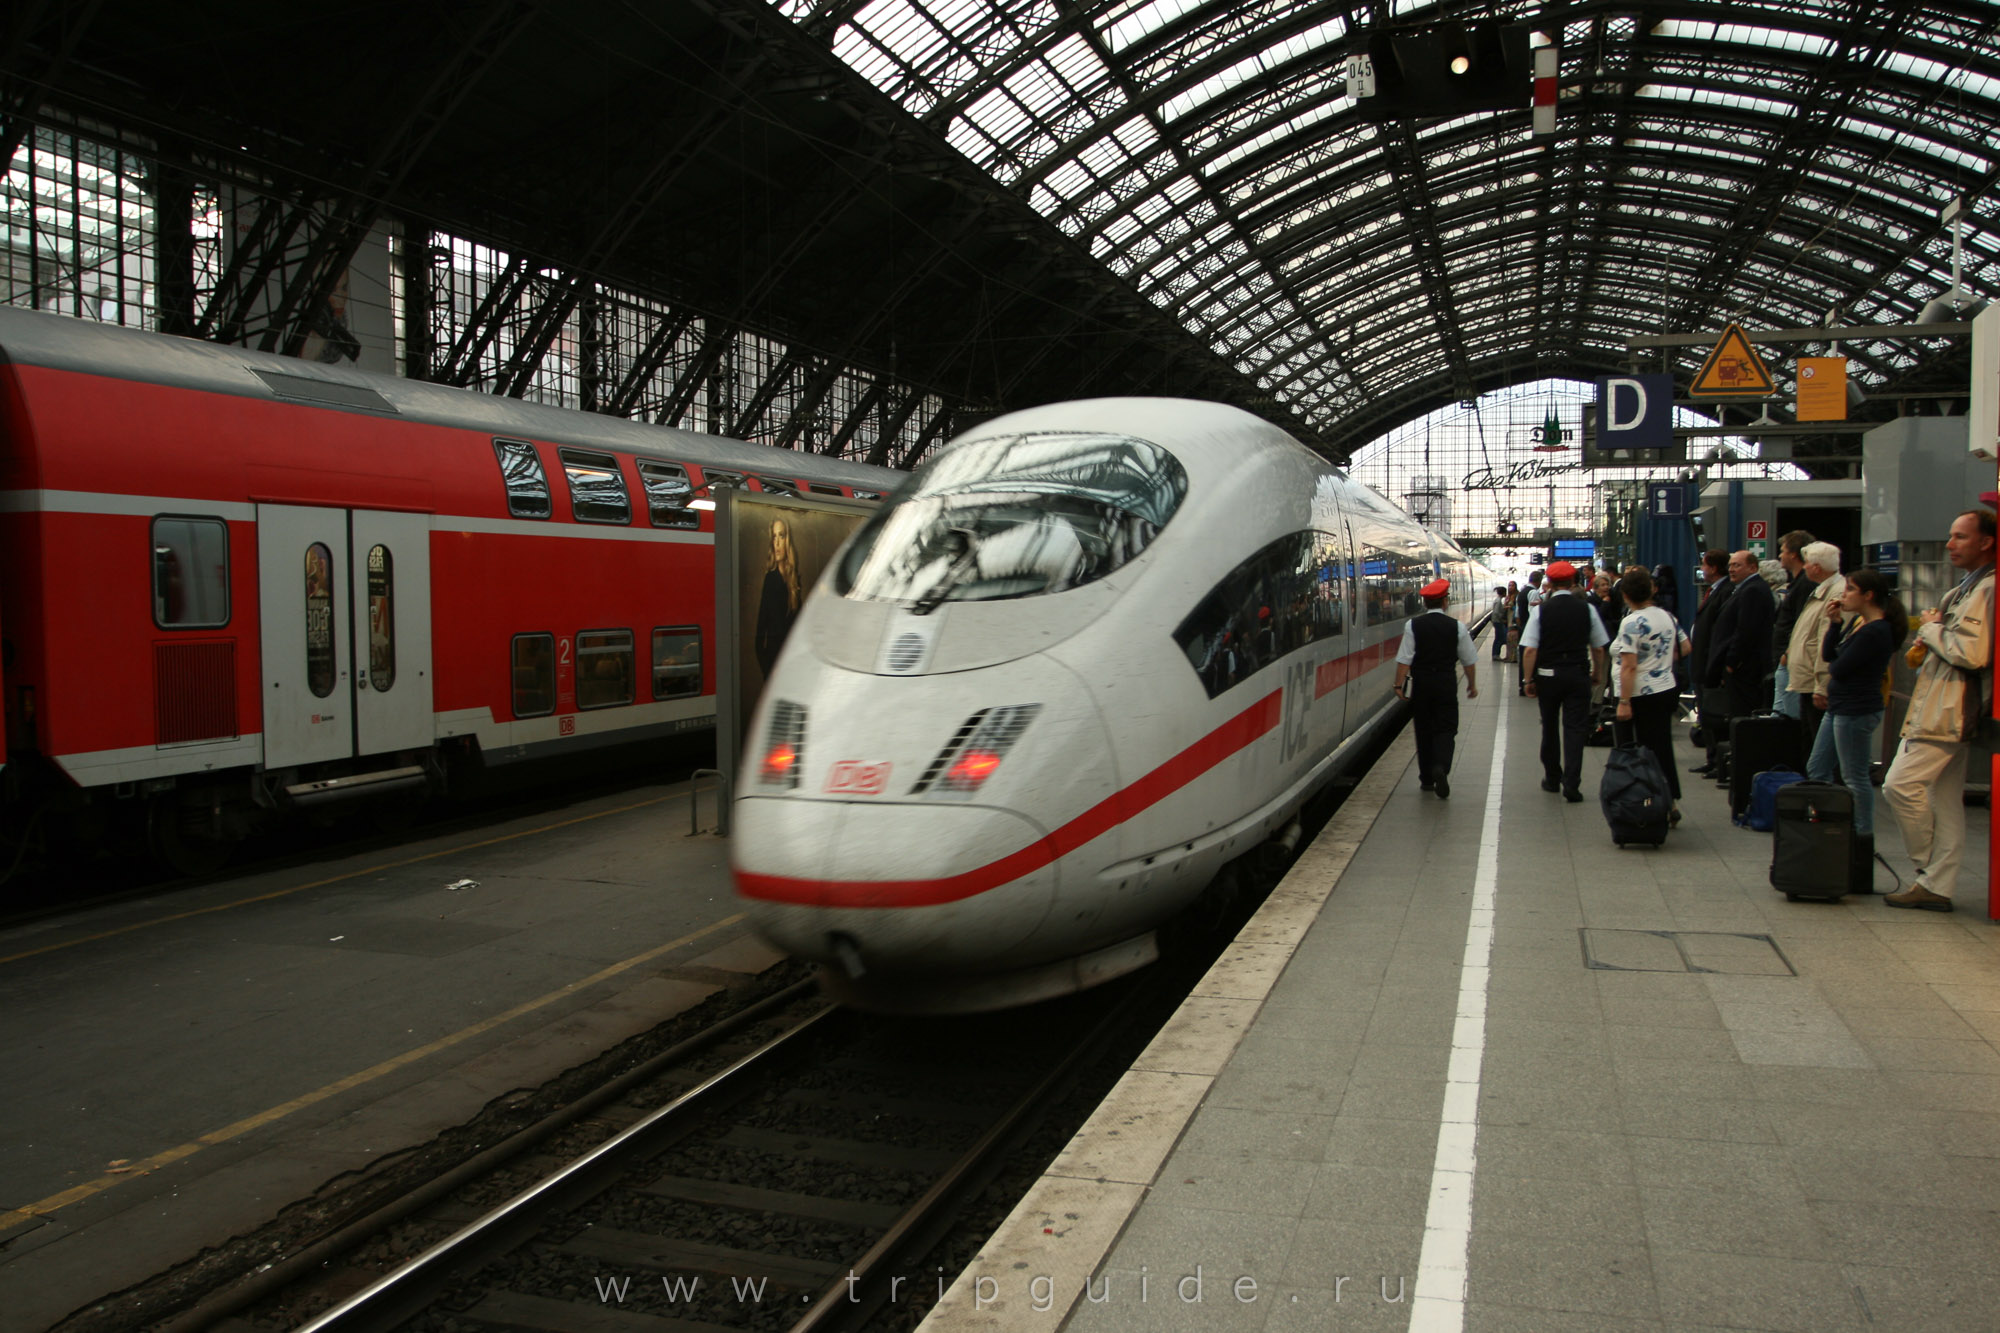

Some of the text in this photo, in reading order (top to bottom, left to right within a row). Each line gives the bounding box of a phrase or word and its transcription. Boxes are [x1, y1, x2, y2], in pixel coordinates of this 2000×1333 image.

[1350, 61, 1371, 78] 045
[1607, 378, 1647, 431] D
[1529, 426, 1573, 443] Dom
[1566, 506, 1593, 520] HB
[1531, 553, 1540, 564] E
[560, 638, 570, 664] 2
[1280, 659, 1315, 765] ICE
[561, 716, 574, 733] DB
[828, 763, 885, 791] DB
